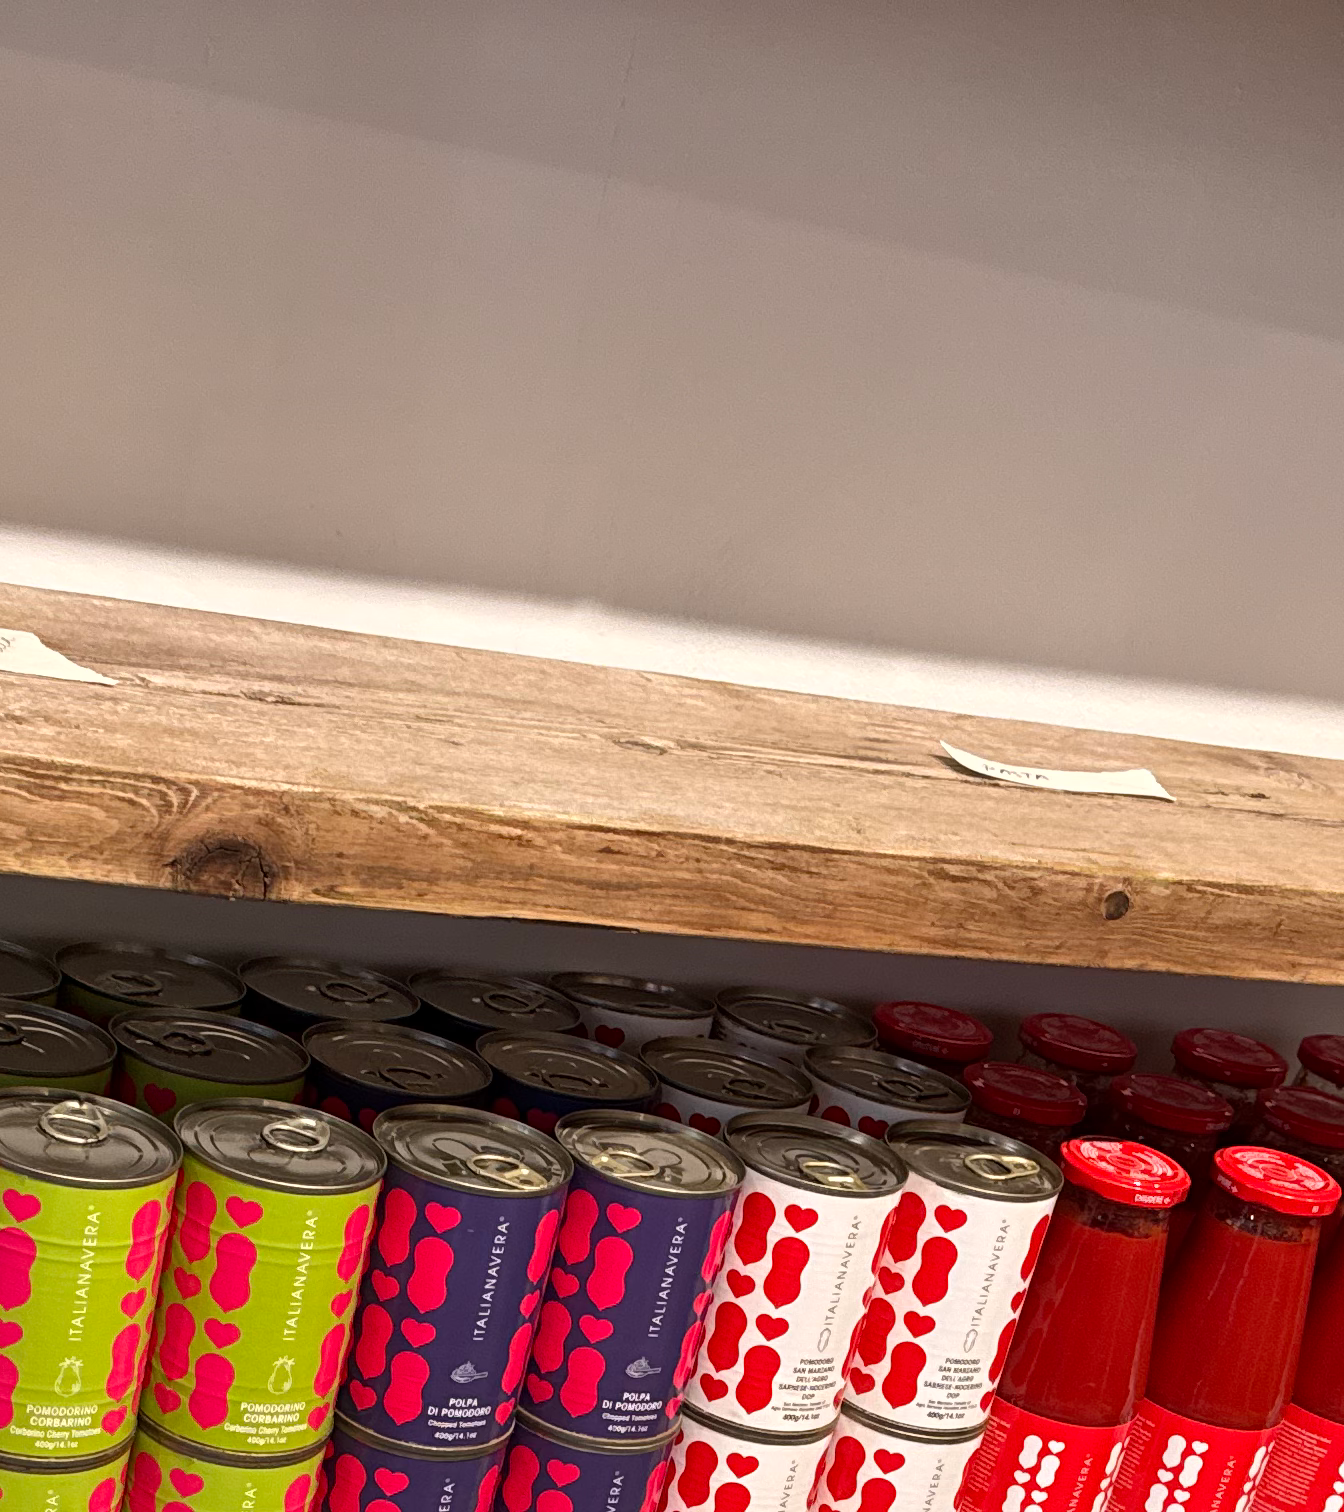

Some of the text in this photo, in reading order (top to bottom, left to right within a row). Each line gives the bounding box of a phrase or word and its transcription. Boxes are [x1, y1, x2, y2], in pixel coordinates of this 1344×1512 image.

[473, 1221, 511, 1341] ITALIANAVERA
[648, 1222, 688, 1338] ITALIANAVERA
[449, 1398, 477, 1407] POLPA
[623, 1393, 650, 1401] POLPA
[26, 1404, 98, 1416] POMODORINO
[240, 1402, 306, 1413] POMODORINO
[602, 1401, 662, 1411] DI POMODORO
[244, 1412, 299, 1423] CORBARINO
[428, 1406, 491, 1418] DI POMODORO
[30, 1416, 92, 1426] CORBARINO
